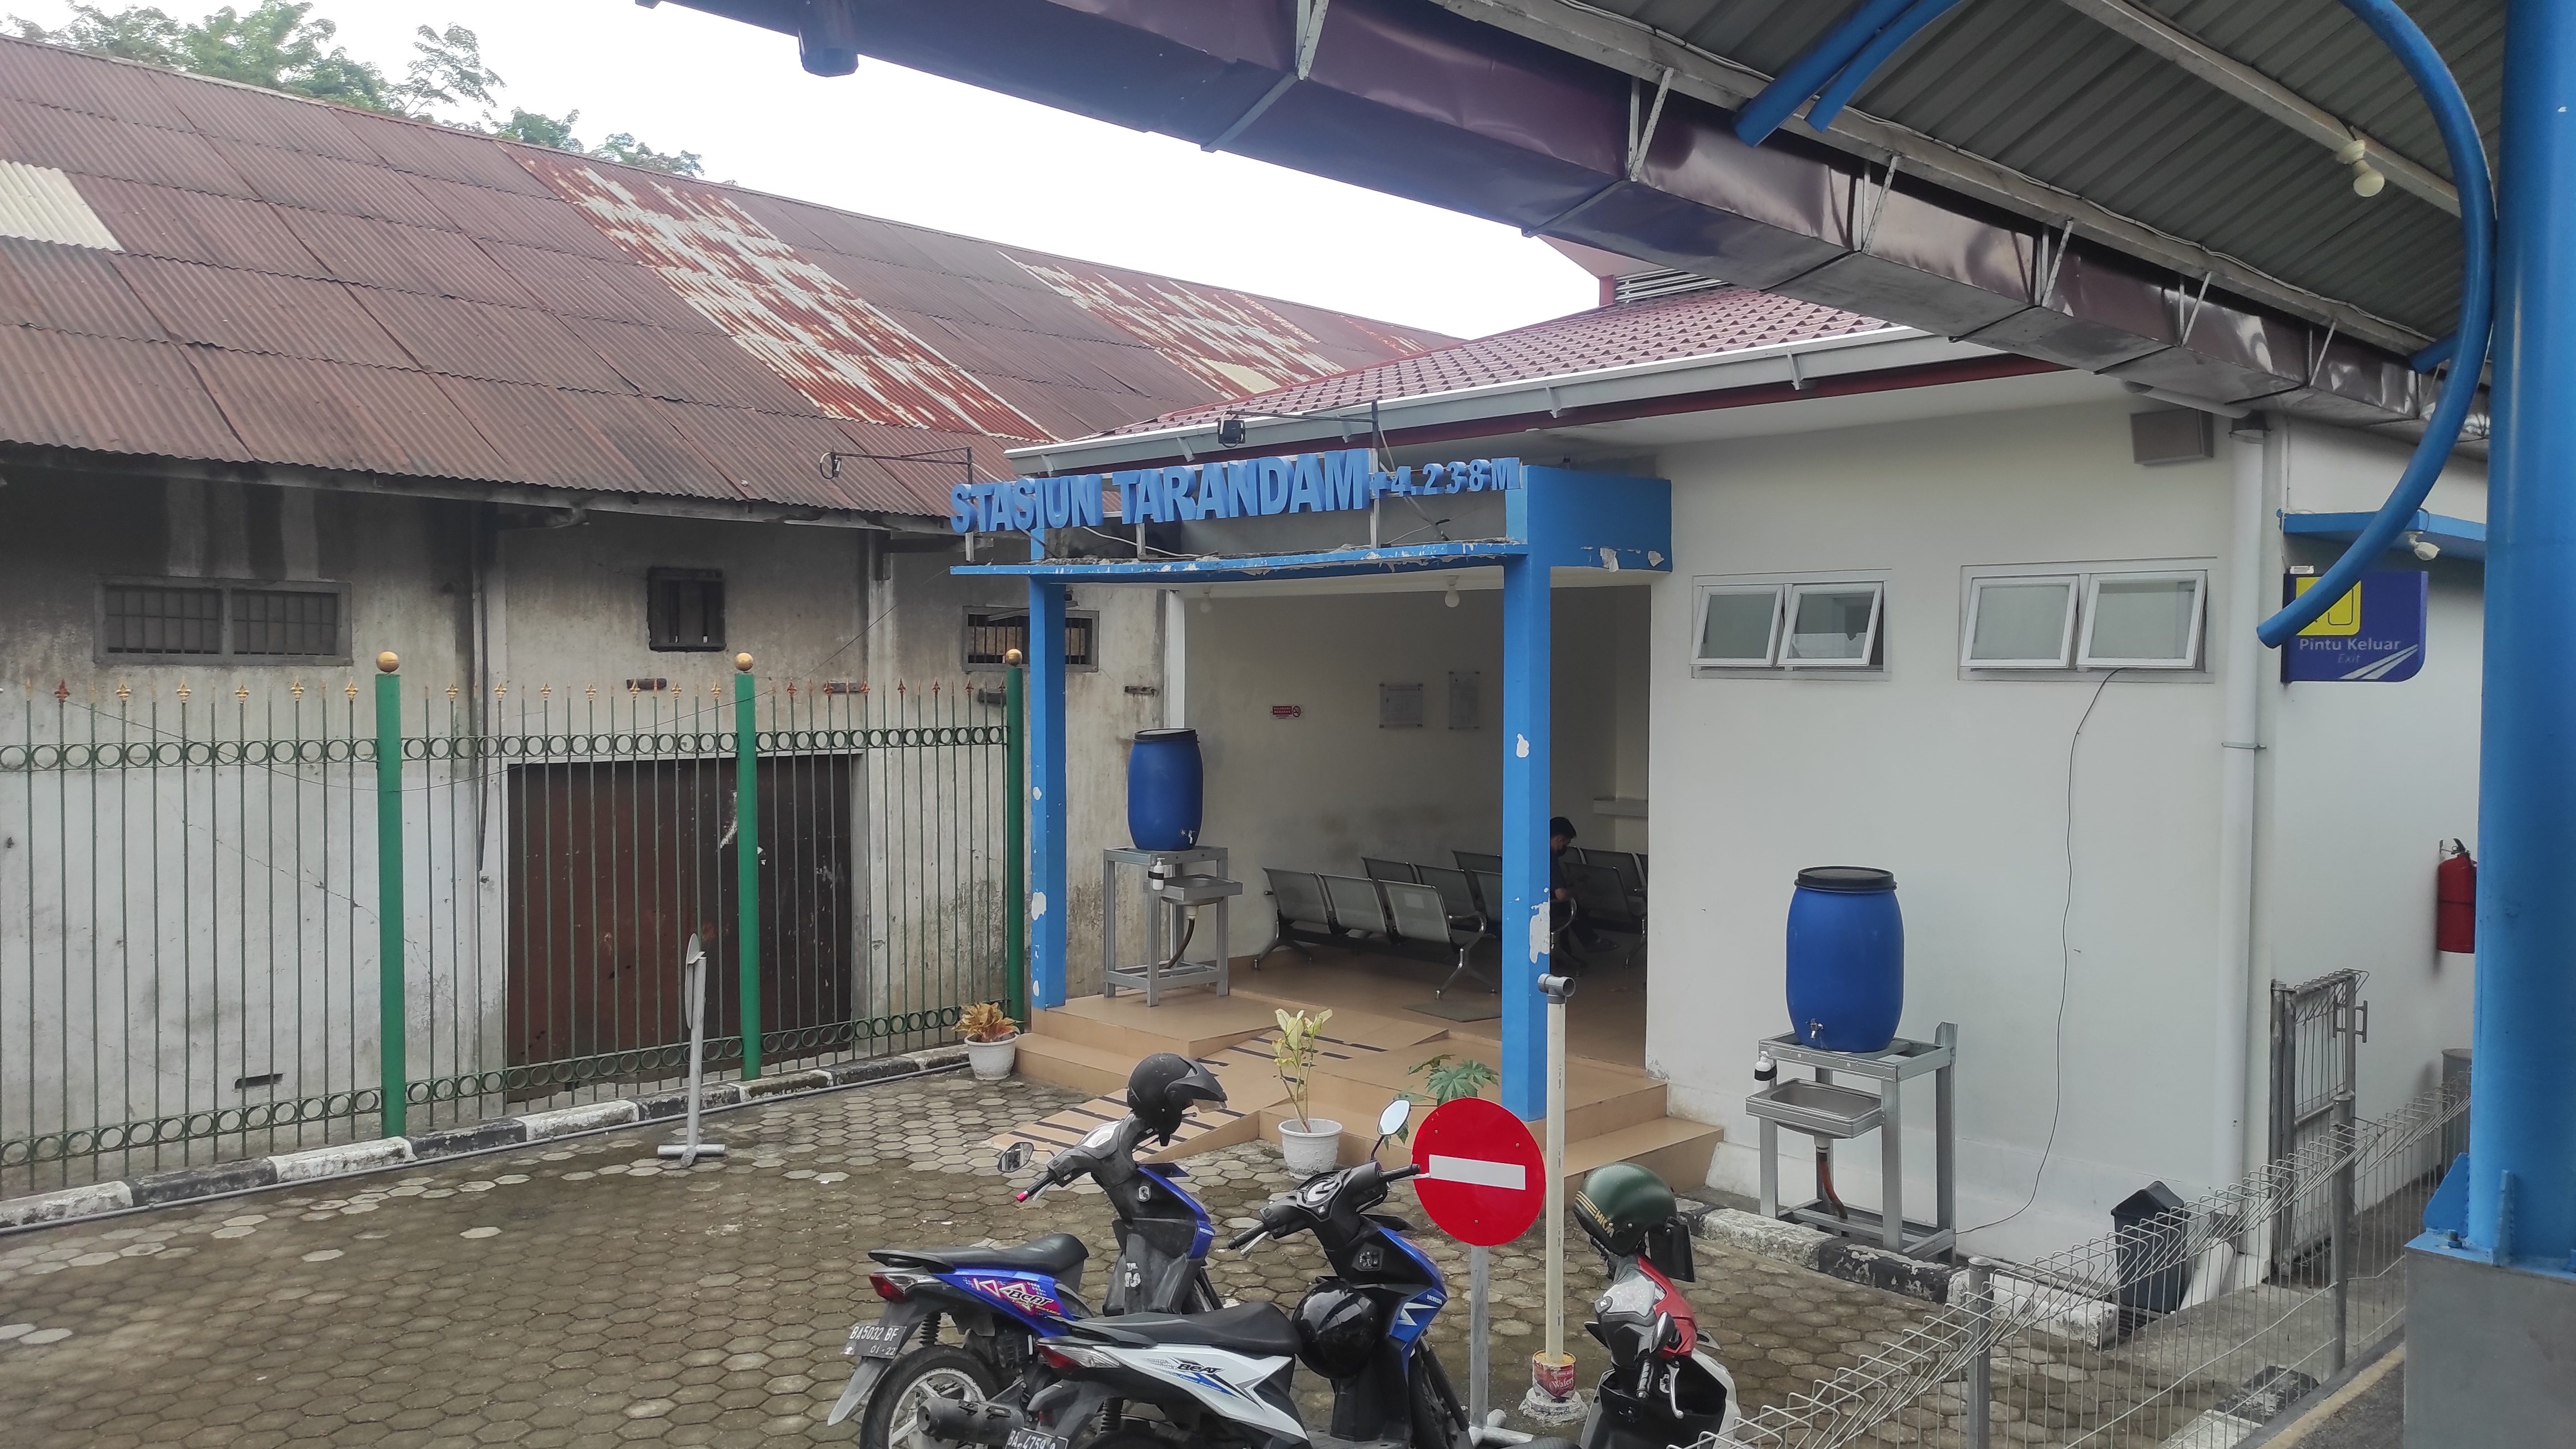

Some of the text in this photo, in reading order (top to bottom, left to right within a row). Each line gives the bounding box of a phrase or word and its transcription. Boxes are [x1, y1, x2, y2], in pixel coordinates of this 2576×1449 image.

[950, 474, 1104, 534] STASIUN
[1112, 449, 1370, 524] TARANDAM
[2299, 637, 2401, 651] Pintu Keluar
[2337, 654, 2361, 664] Exit
